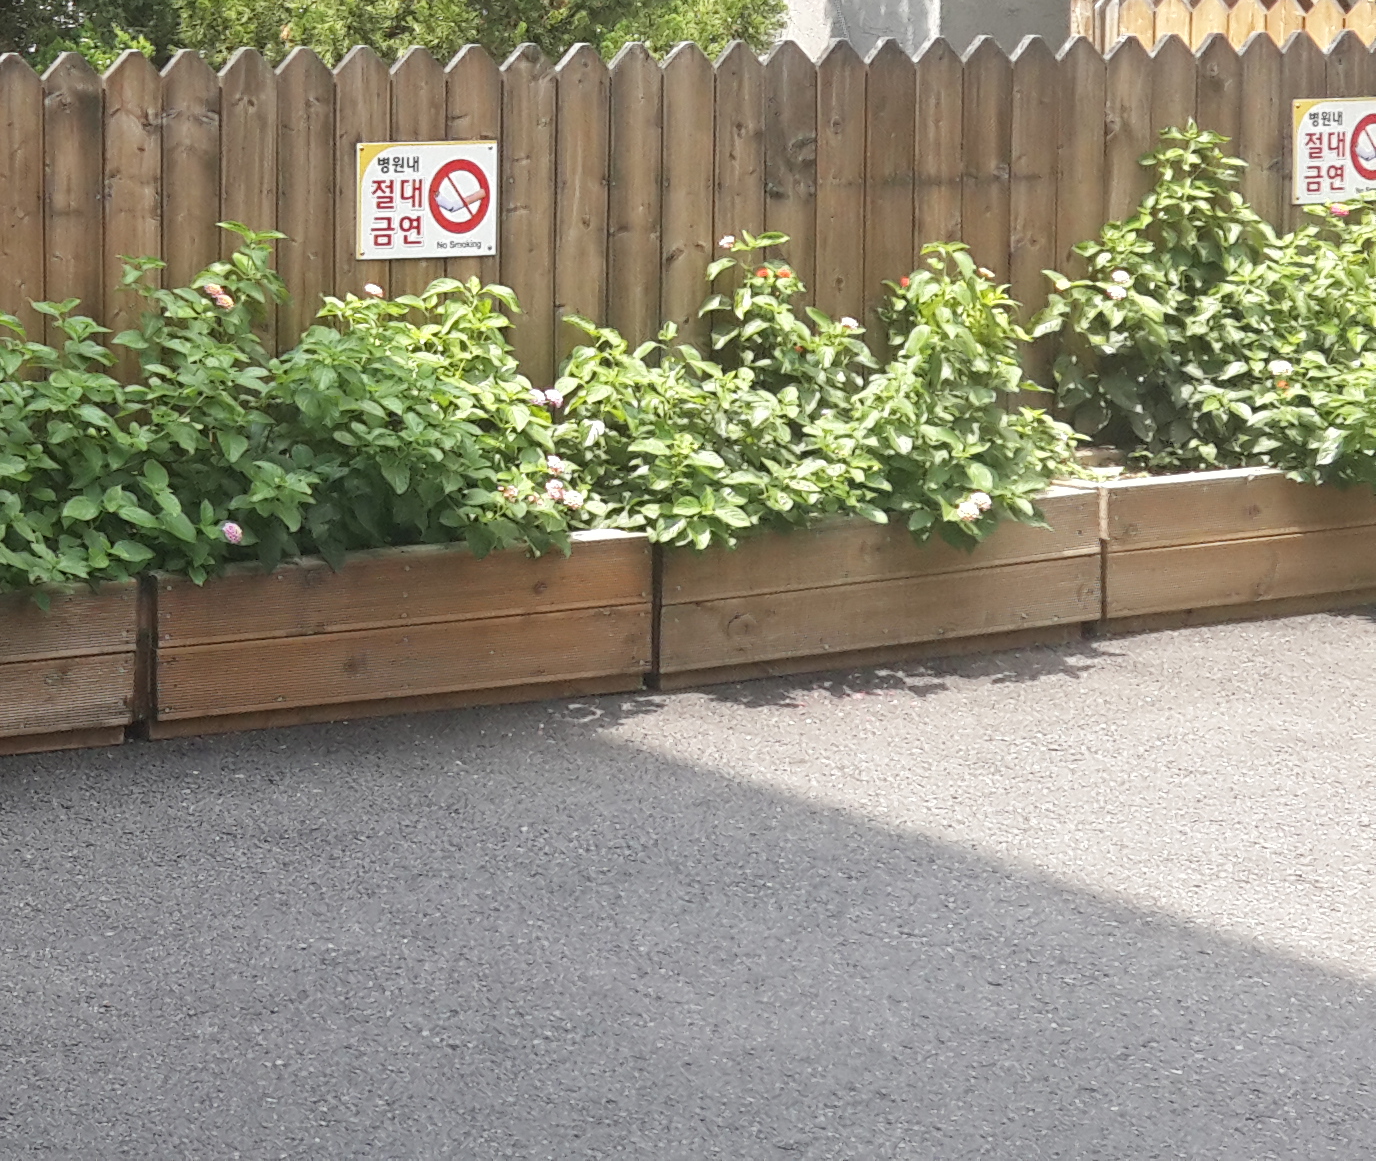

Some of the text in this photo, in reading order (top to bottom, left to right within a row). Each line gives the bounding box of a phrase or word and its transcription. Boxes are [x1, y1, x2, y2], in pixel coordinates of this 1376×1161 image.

[1309, 111, 1343, 127] 병원내
[1305, 131, 1346, 158] 절대
[377, 156, 420, 173] 병원내
[1304, 165, 1345, 192] 금연
[371, 179, 423, 210] 절대
[370, 215, 423, 247] 금연
[436, 240, 482, 249] No Smoking
